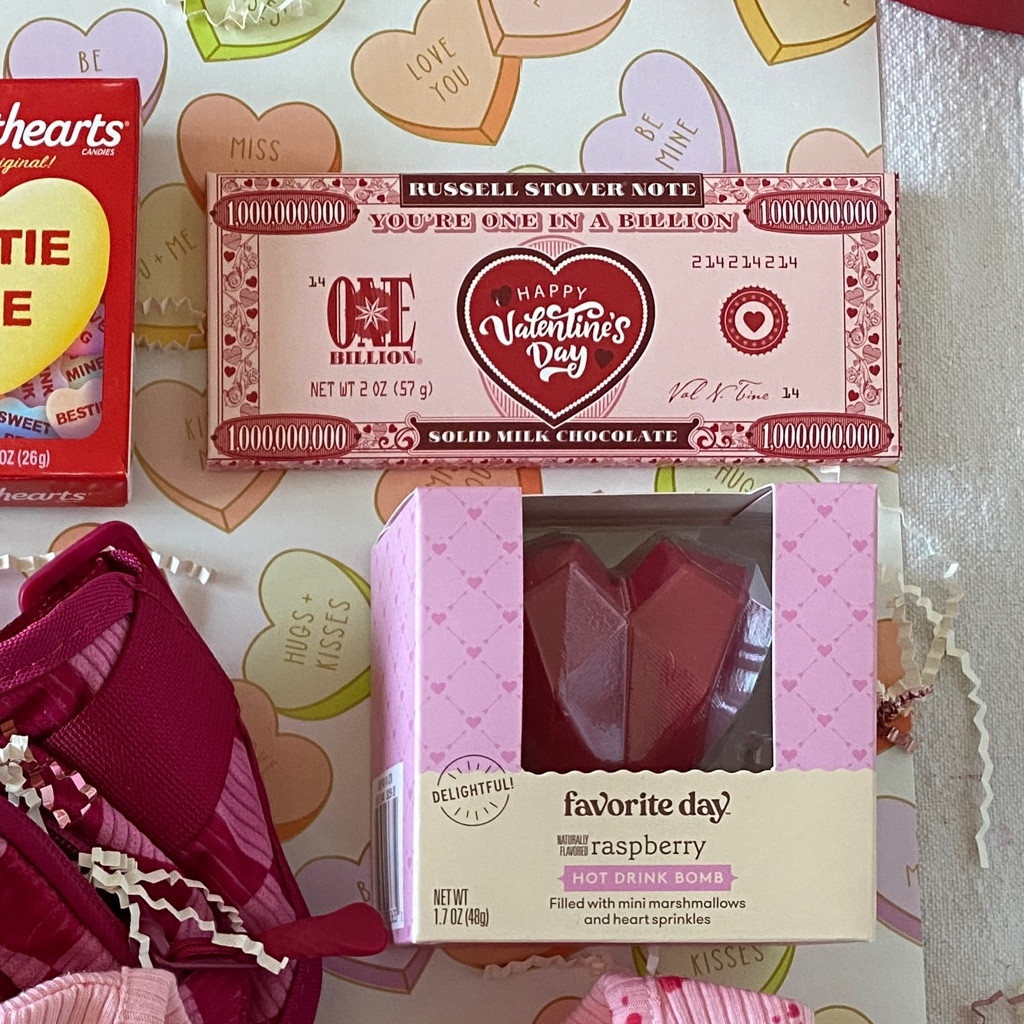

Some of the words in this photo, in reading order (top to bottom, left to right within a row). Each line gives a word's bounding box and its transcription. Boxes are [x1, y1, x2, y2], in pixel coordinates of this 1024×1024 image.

[78, 49, 103, 74] BE
[405, 35, 458, 82] LOVE
[428, 66, 472, 103] YOU
[634, 112, 665, 143] BE
[81, 148, 115, 156] CANDIES
[229, 136, 281, 162] MISS
[655, 116, 699, 173] MINE
[408, 182, 519, 197] RUSSELL
[524, 181, 625, 197] STOVER
[631, 181, 696, 197] NOTE
[227, 199, 346, 226] 1,000,000,000
[369, 211, 475, 233] YOU'RE
[481, 211, 538, 232] ONE
[547, 211, 583, 232] IN
[589, 211, 614, 232] A
[617, 211, 739, 233] BILLION
[759, 199, 878, 227] 1,000,000,000
[165, 228, 198, 260] ME
[308, 276, 326, 288] 14
[516, 283, 588, 301] HAPPY
[326, 273, 417, 350] ONE
[478, 301, 631, 346] Valentine's
[329, 350, 417, 365] BILLION
[526, 341, 588, 382] Day
[310, 381, 335, 397] NET
[339, 381, 355, 397] WT
[360, 381, 368, 397] 2
[372, 381, 387, 397] OZ
[393, 380, 415, 397] (57
[419, 381, 433, 400] g)
[669, 378, 708, 404] Val
[781, 386, 800, 399] 14
[228, 423, 347, 452] 1,000,000,000
[427, 429, 492, 443] SOLID
[496, 429, 551, 443] MILK
[555, 429, 678, 443] CHOCOLATE
[761, 421, 880, 450] 1,000,000,000
[0, 449, 14, 465] OZ
[17, 449, 50, 469] (26g)
[284, 609, 315, 665] HUGS
[316, 598, 351, 671] KISSES
[432, 777, 515, 803] DELIGHTFUL!
[564, 790, 674, 817] favorite
[678, 790, 731, 824] day
[556, 835, 589, 845] NATURALLY
[559, 846, 589, 857] FLAVORED
[591, 834, 707, 860] raspberry
[572, 872, 608, 884] HOT
[614, 872, 668, 884] DRINK
[675, 872, 724, 884] BOMB
[433, 889, 451, 905] NET
[452, 889, 468, 905] WT
[549, 897, 585, 909] Filled
[587, 897, 615, 909] with
[618, 897, 646, 909] mini
[648, 897, 746, 909] marshmallows
[433, 908, 448, 925] 1.7
[450, 908, 463, 925] OZ
[465, 907, 489, 927] (48g)
[584, 913, 610, 925] and
[613, 913, 650, 925] heart
[652, 913, 711, 928] sprinkles
[690, 945, 766, 976] KISSES
